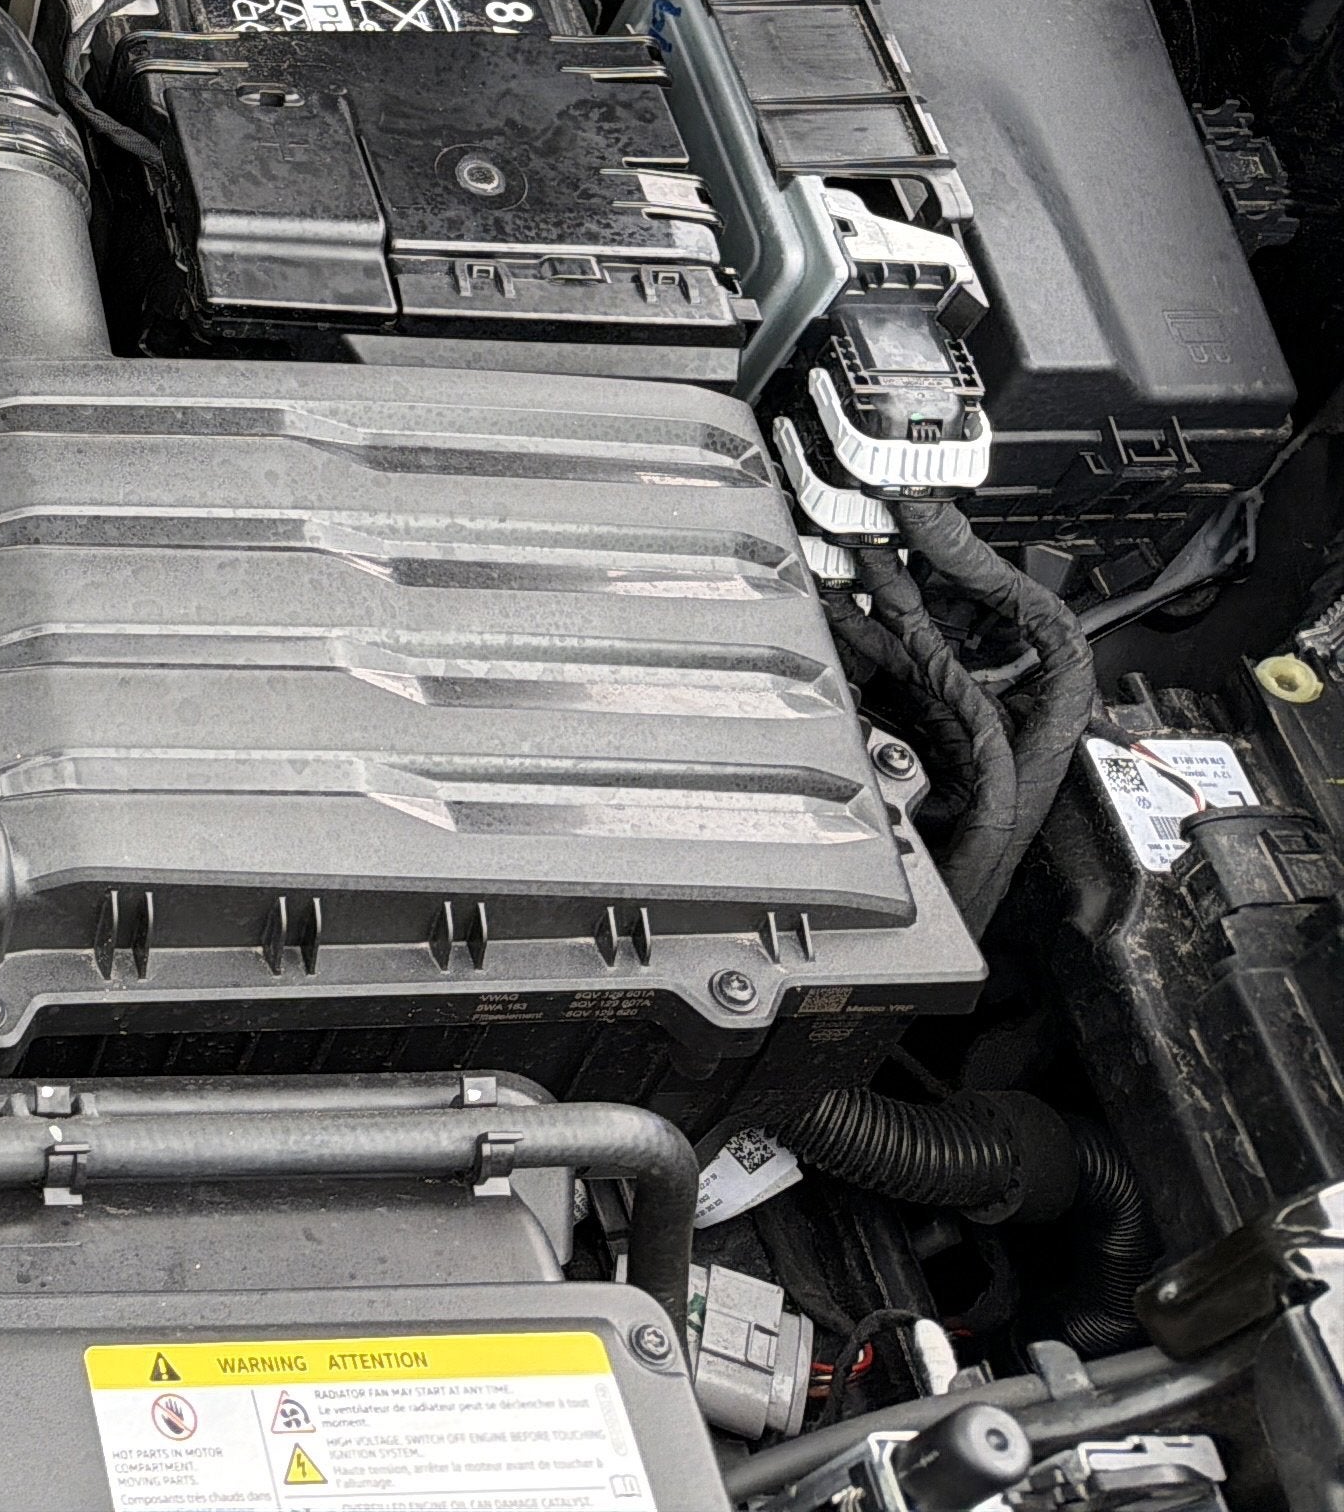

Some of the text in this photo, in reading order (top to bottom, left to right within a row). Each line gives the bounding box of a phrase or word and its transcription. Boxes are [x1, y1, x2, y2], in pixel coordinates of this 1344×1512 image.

[216, 1351, 429, 1374] WARNING ATTENTION
[315, 1388, 366, 1400] RADIATOR
[414, 1386, 446, 1397] START
[318, 1405, 331, 1415] Le
[333, 1404, 391, 1415] ventilateur
[392, 1402, 406, 1413] de
[408, 1401, 456, 1413] radiateur
[458, 1401, 483, 1414] peut
[112, 1450, 135, 1460] HOT
[136, 1449, 170, 1459] PARTS
[184, 1447, 224, 1458] MOTOR
